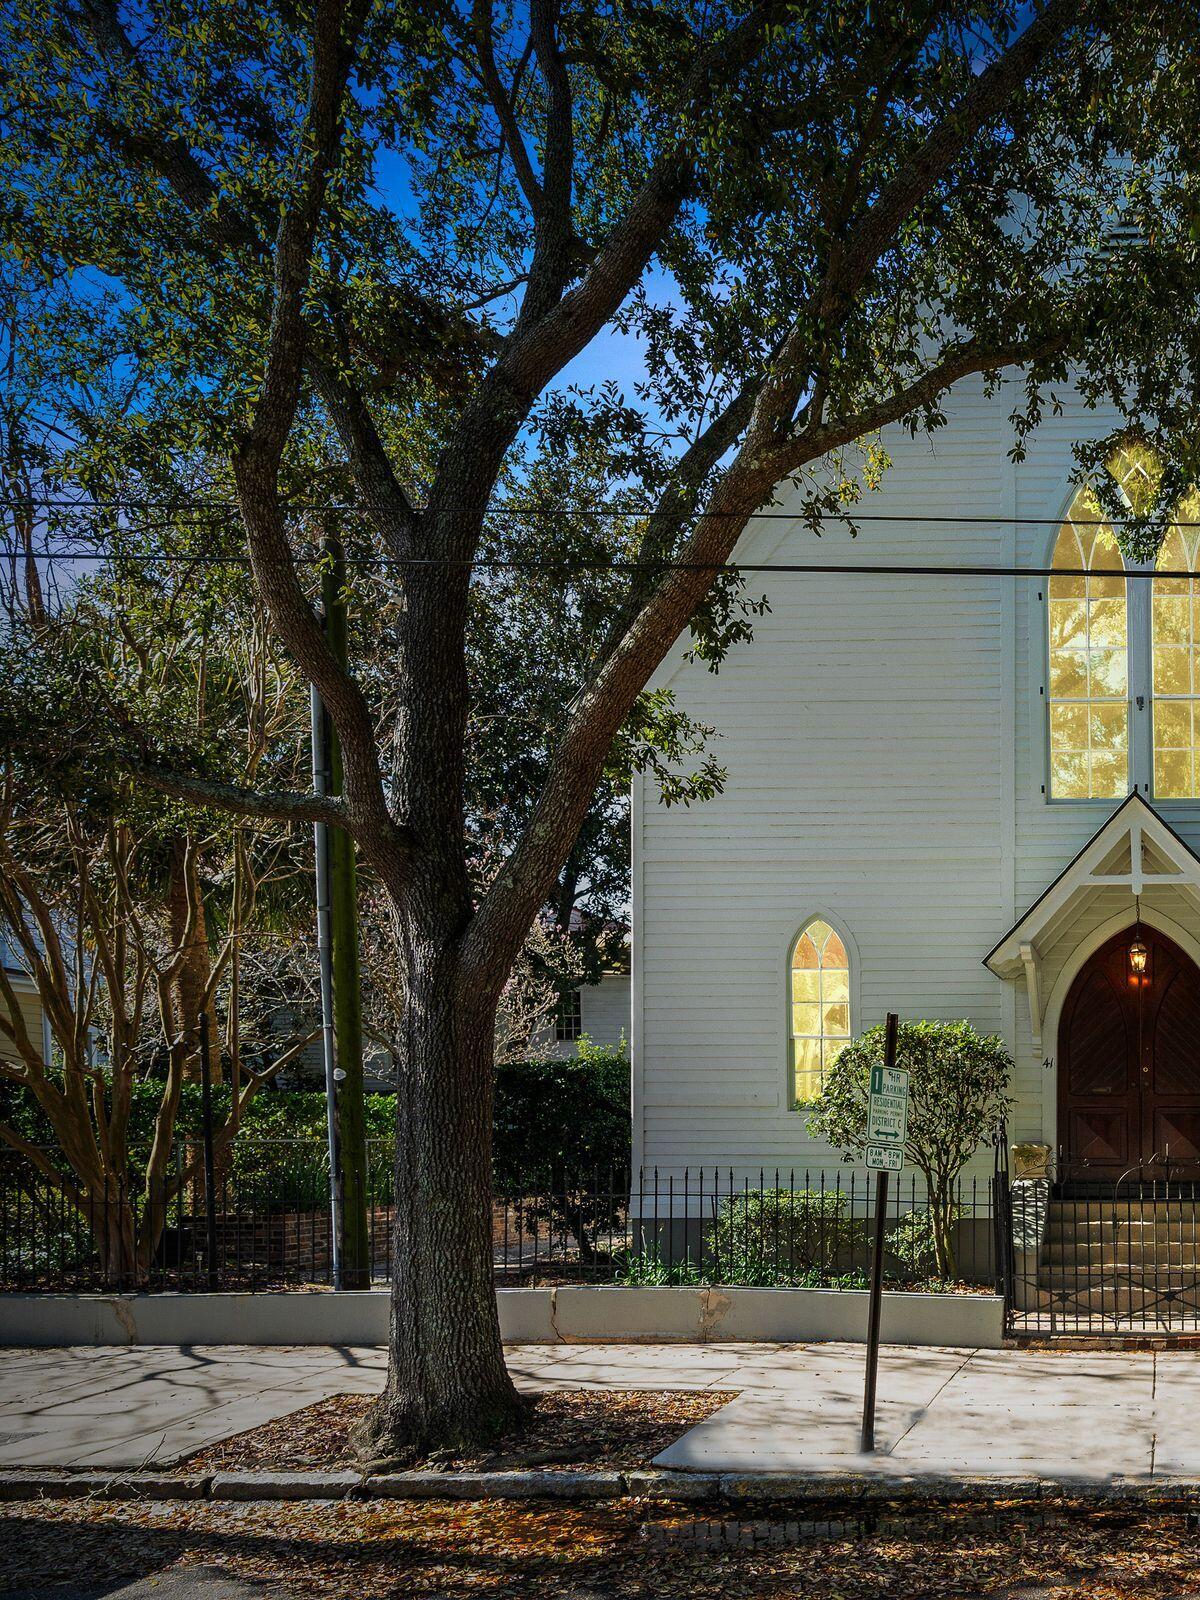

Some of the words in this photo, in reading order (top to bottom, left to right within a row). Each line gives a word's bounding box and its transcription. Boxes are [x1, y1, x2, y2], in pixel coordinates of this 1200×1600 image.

[1042, 1057, 1054, 1069] 41
[875, 1071, 879, 1090] 1
[891, 1073, 901, 1083] HR
[883, 1083, 906, 1097] PARKING
[874, 1096, 903, 1110] RESIDENTIAL
[872, 1115, 895, 1128] DISTRICT
[897, 1119, 902, 1129] C
